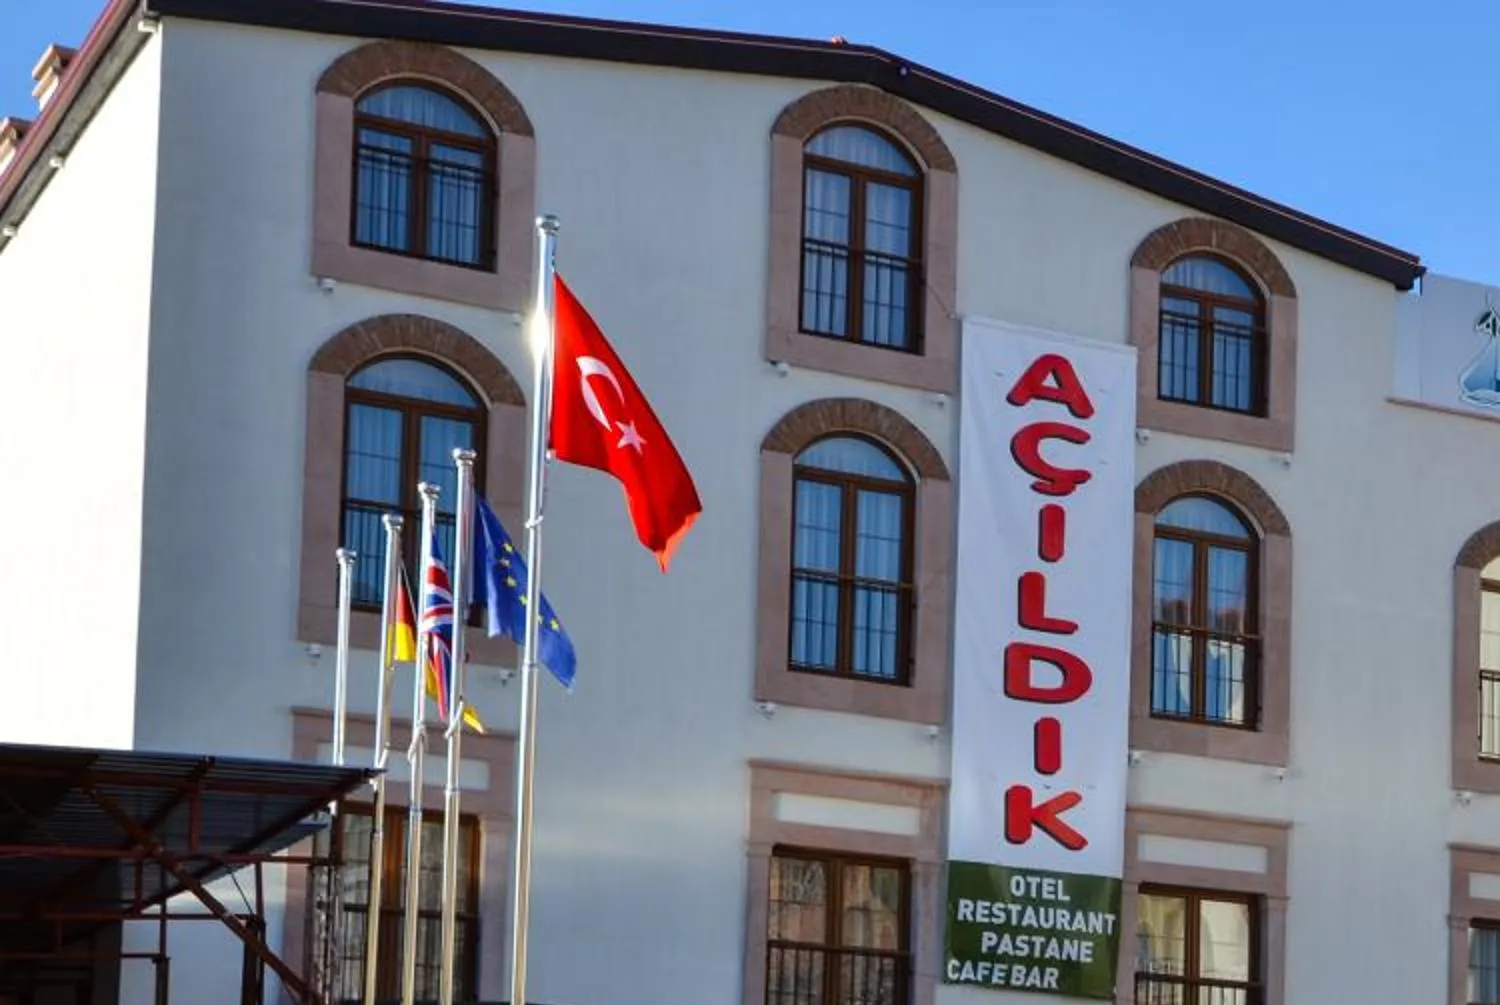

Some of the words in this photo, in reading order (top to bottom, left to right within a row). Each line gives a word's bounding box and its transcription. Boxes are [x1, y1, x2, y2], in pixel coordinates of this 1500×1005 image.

[1004, 353, 1095, 852] AÇILDIK
[1010, 875, 1070, 901] OTEL
[957, 898, 1116, 935] RESTAURANT
[980, 931, 1093, 963] PASTANE
